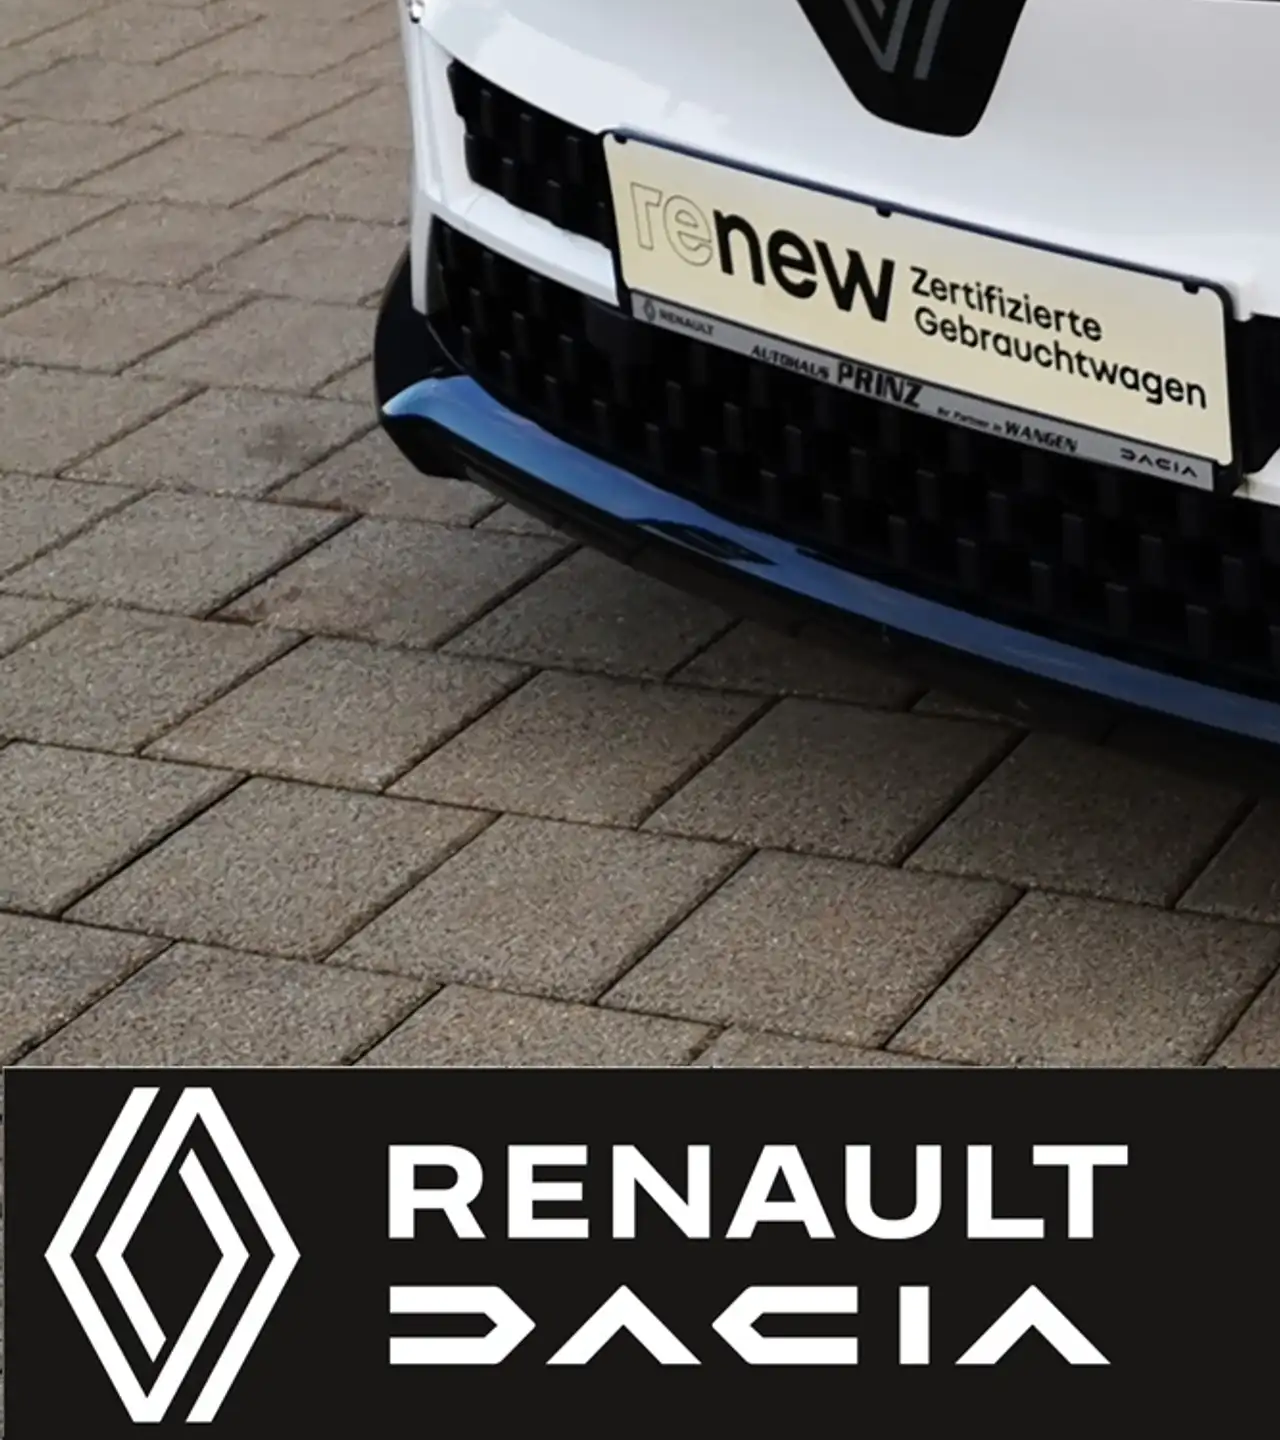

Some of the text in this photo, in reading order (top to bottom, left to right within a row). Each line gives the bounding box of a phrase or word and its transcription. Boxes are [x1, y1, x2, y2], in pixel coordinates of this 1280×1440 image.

[630, 181, 895, 322] renew
[910, 266, 1103, 342] Zertifizierte
[751, 344, 923, 408] AUTOHAUS PRINZ
[914, 307, 1207, 410] Gebrauchtwagen
[1004, 420, 1078, 453] WANGEN
[1120, 446, 1198, 479] DACIA
